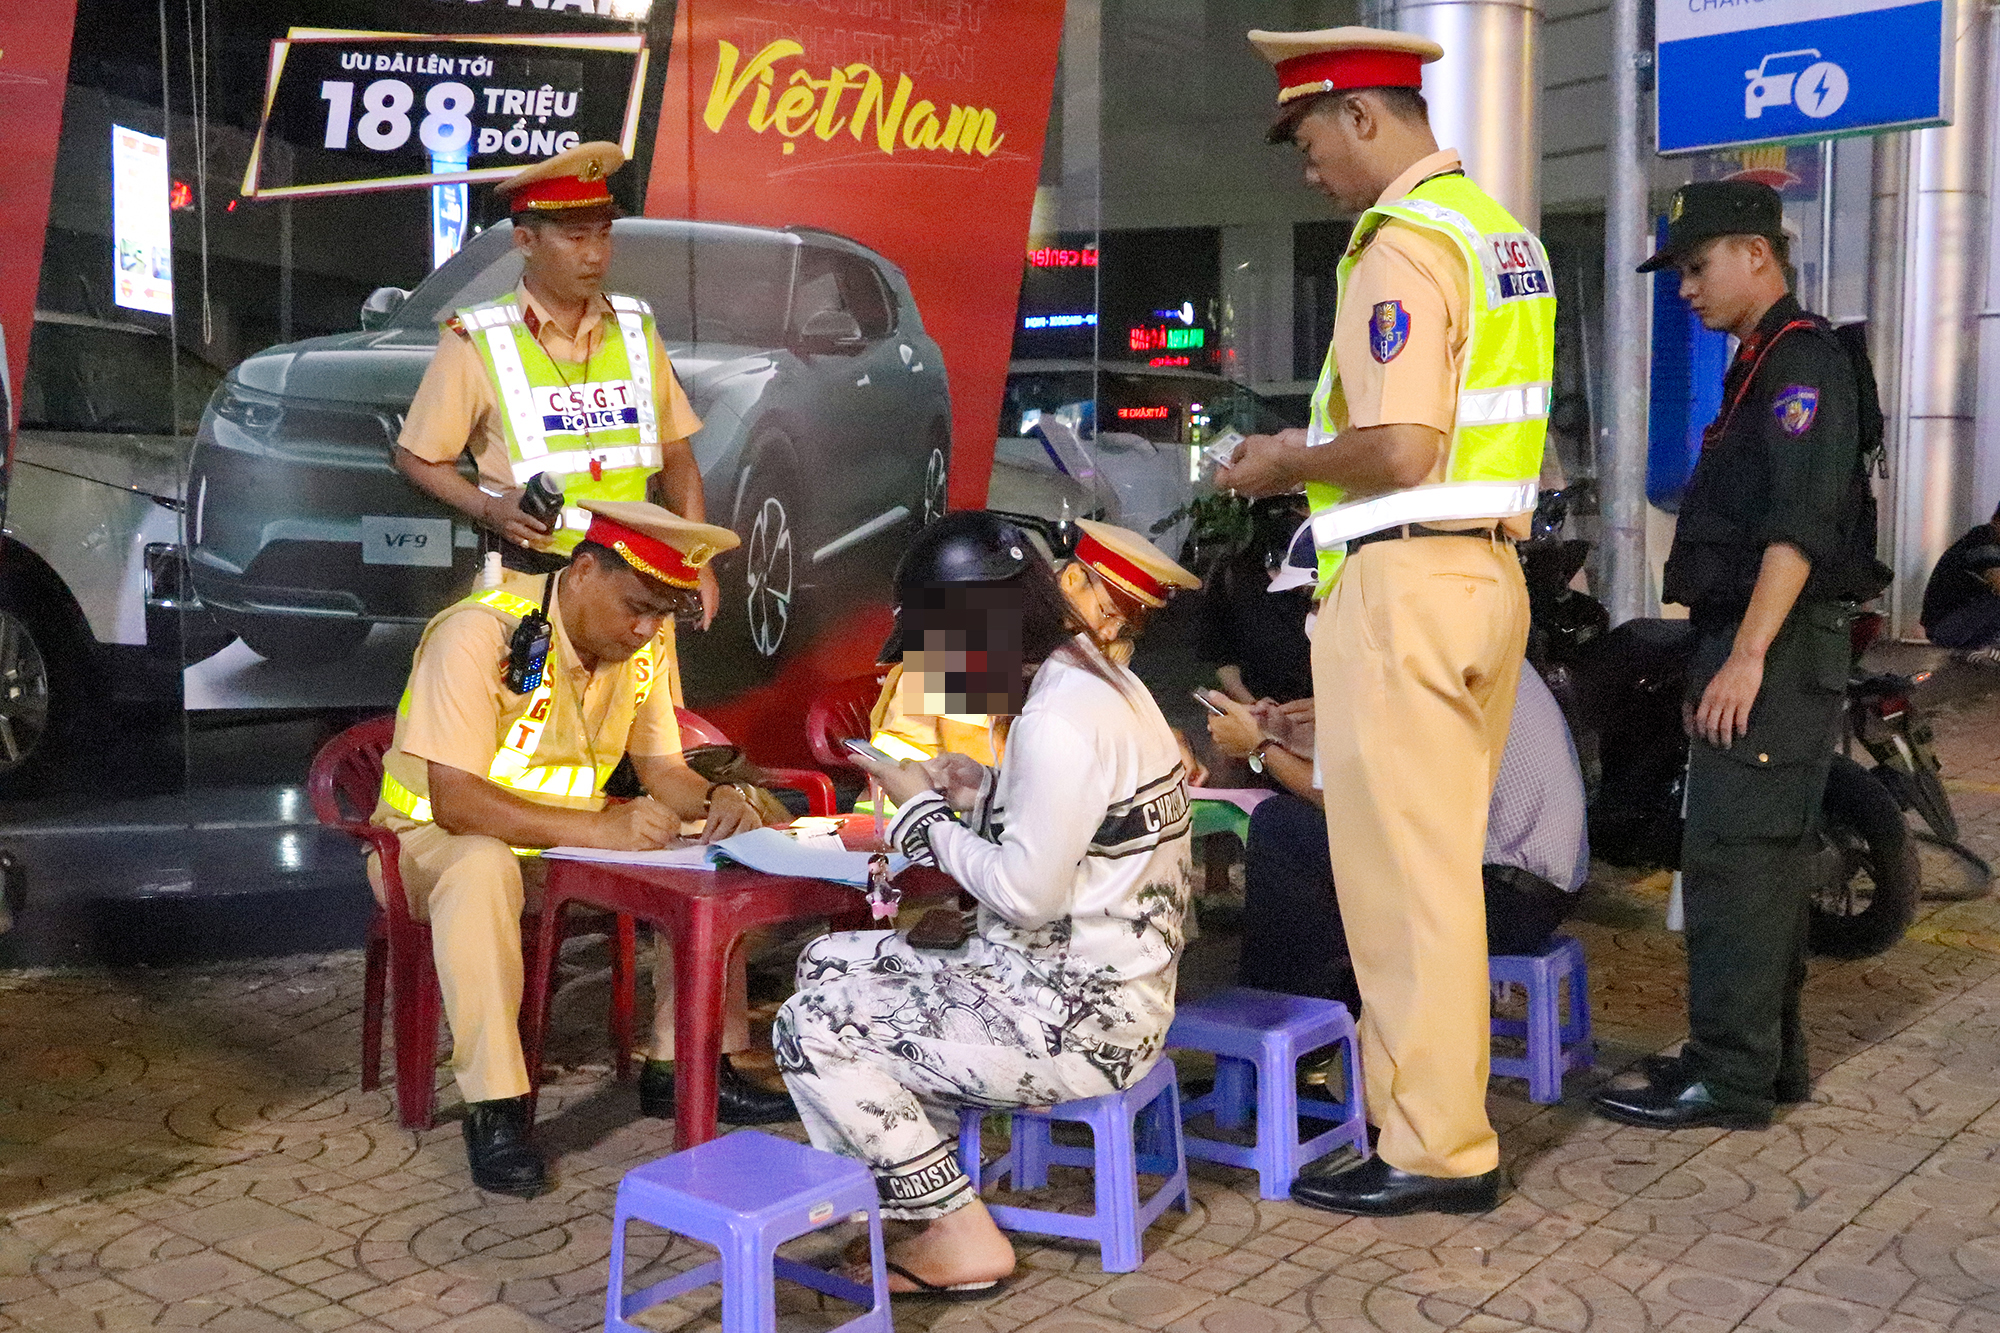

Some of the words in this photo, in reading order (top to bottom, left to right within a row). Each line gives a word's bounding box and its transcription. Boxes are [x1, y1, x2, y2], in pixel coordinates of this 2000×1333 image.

[341, 52, 371, 71] ƯU
[375, 53, 413, 73] ĐÃI
[417, 54, 455, 75] LÊN
[458, 56, 494, 77] TỚI
[320, 79, 475, 151] 188
[483, 84, 579, 123] TRIỆU
[703, 39, 860, 155] Việt
[846, 63, 1004, 157] Nam
[478, 117, 580, 156] ĐỒNG
[561, 410, 625, 430] POLICE
[384, 533, 428, 548] VF9
